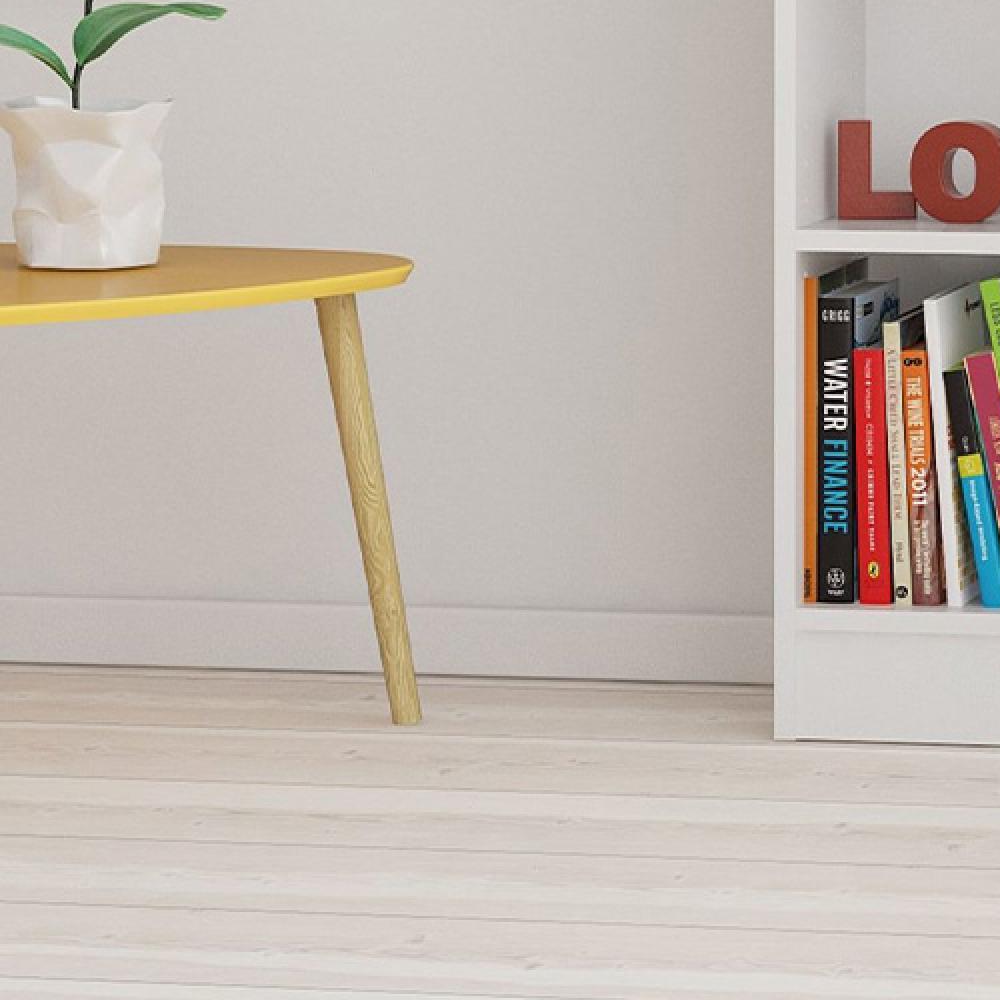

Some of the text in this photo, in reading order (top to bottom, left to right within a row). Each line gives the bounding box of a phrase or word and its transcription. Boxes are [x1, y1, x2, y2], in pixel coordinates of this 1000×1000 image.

[906, 377, 921, 397] THE
[907, 399, 923, 426] WINE
[823, 358, 849, 533] WATER FINANCE
[909, 429, 925, 465] TRIALS
[911, 468, 928, 506] 2011
